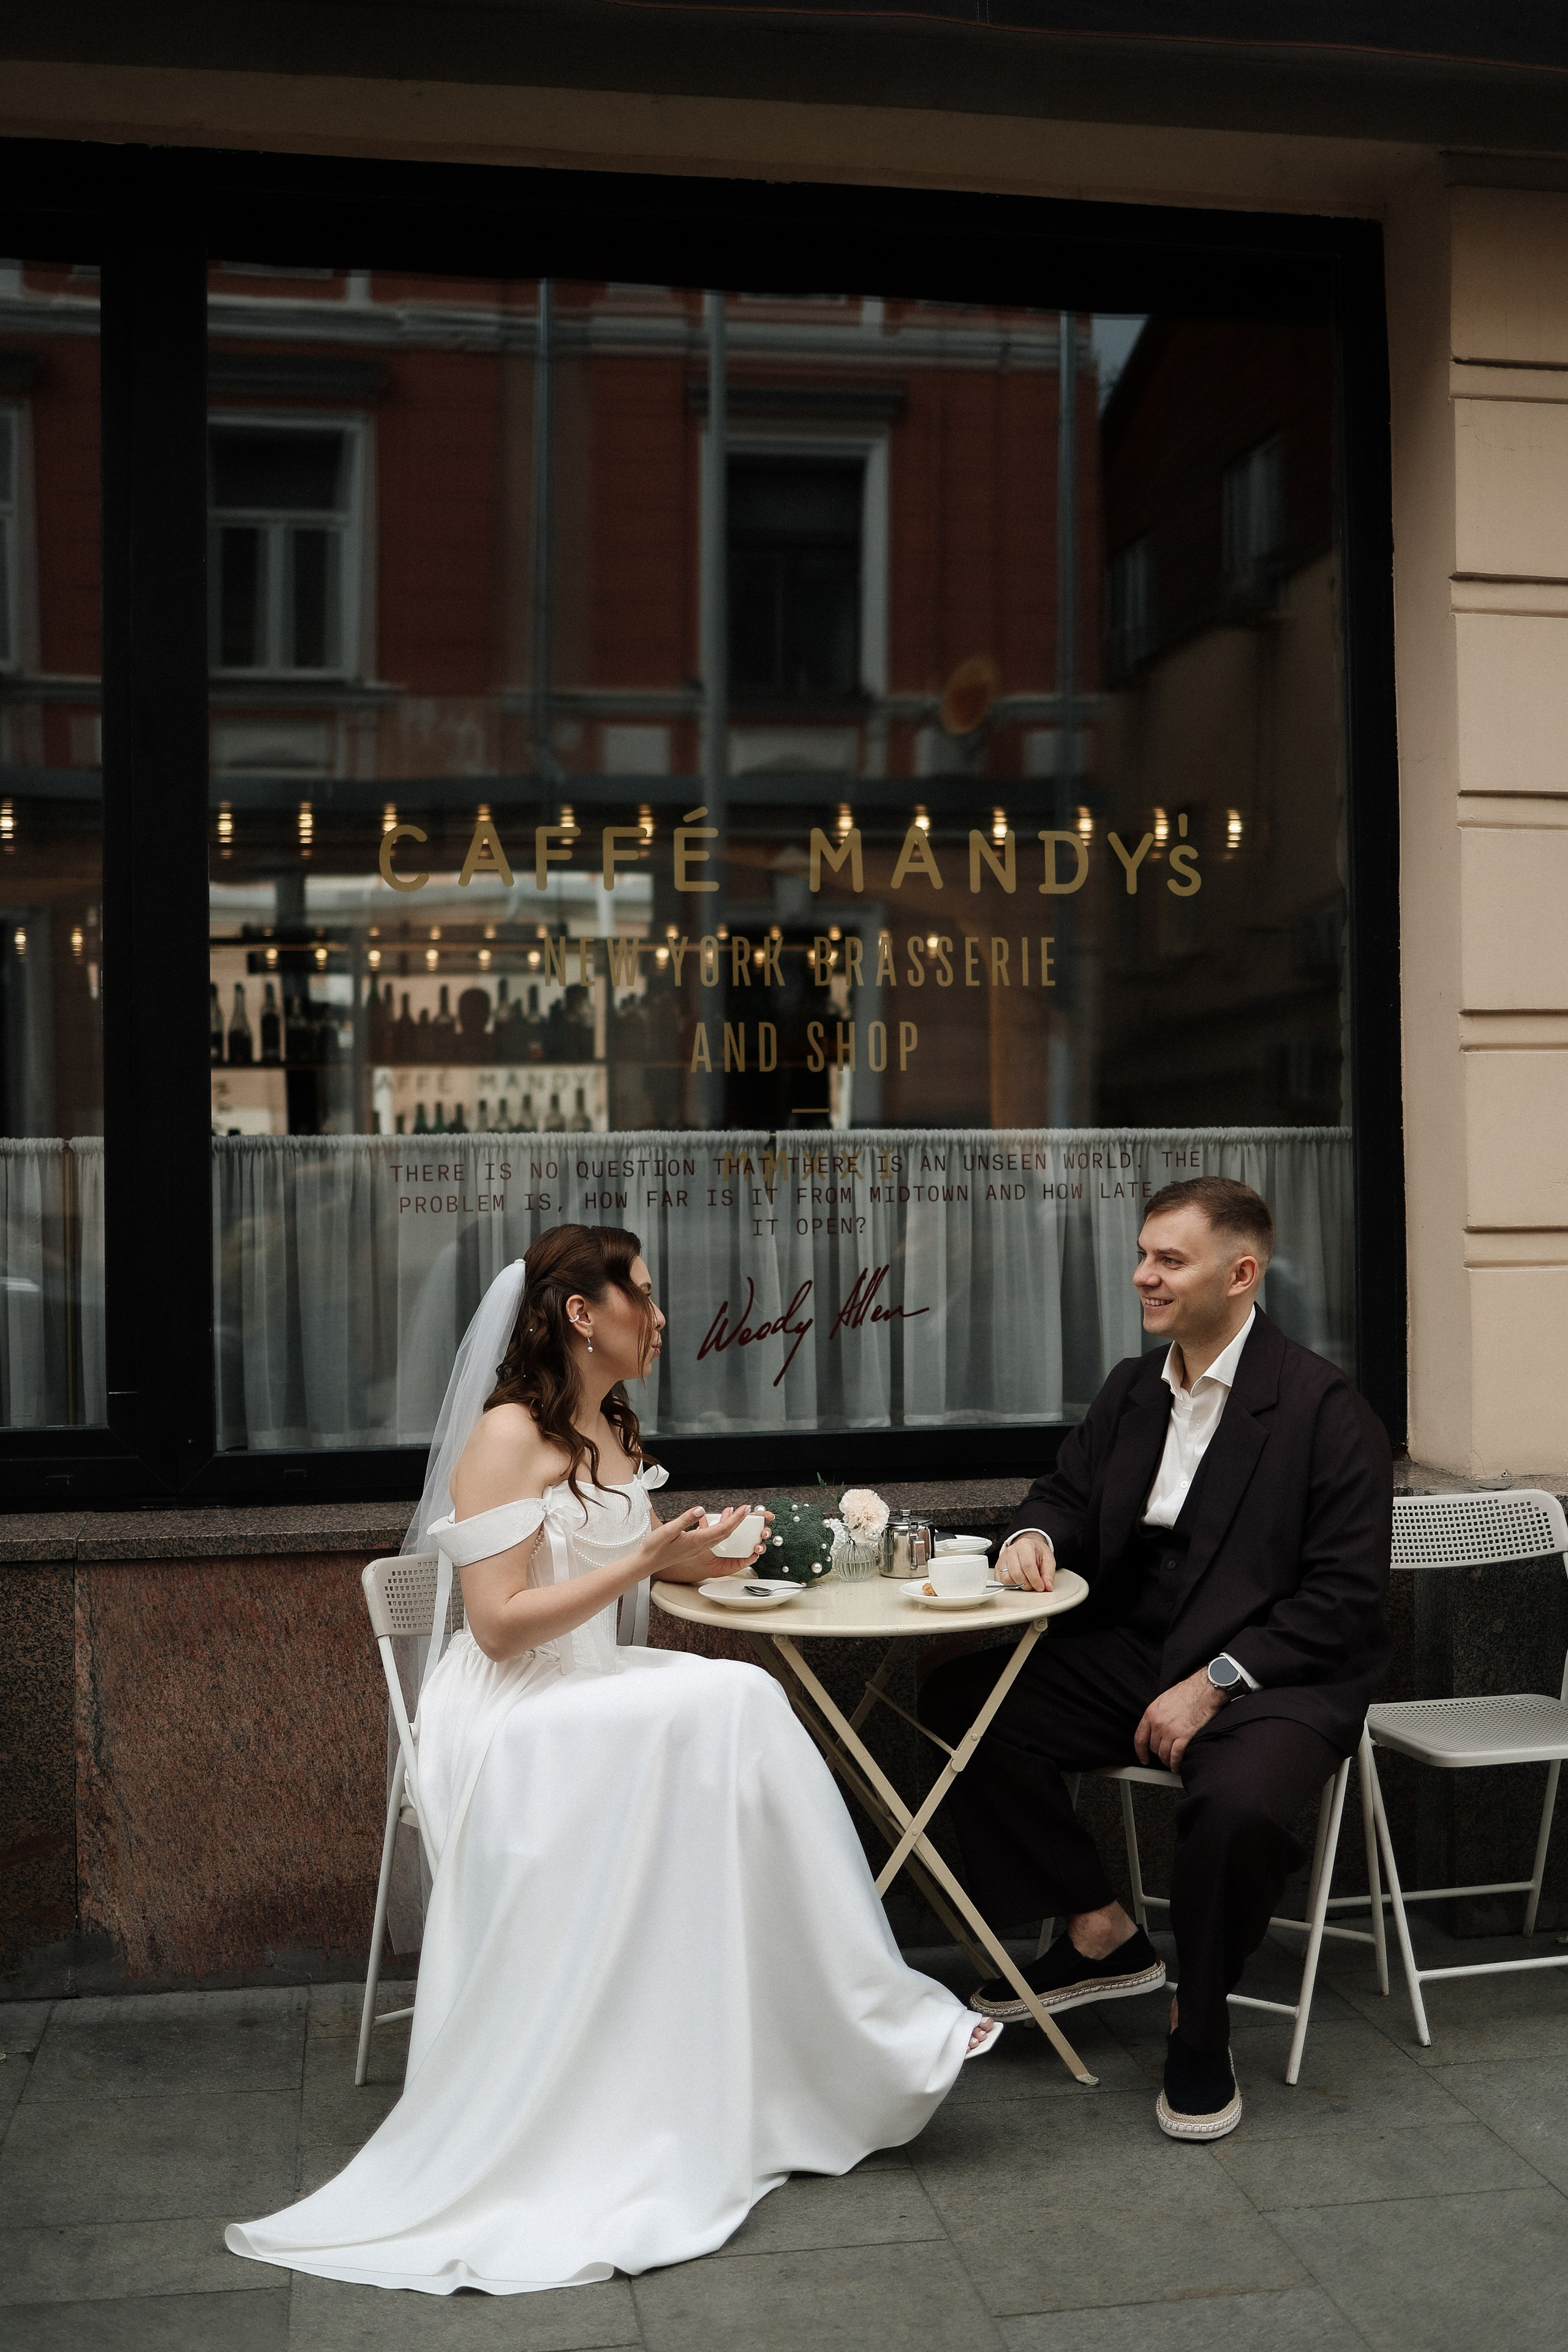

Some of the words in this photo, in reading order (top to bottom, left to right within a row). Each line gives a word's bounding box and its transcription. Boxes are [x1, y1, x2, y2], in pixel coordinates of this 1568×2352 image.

[379, 806, 720, 892] CAFFÉ
[543, 936, 640, 987] NEW
[668, 935, 786, 987] YORK
[813, 937, 1056, 987] BRASSERIE
[690, 1022, 777, 1073] AND
[806, 1021, 918, 1072] SHOP
[390, 1164, 465, 1183] THERE
[485, 1163, 511, 1180] IS
[530, 1162, 558, 1180] NO
[576, 1159, 695, 1180] QUESTION
[713, 1158, 770, 1175] THAT
[787, 1156, 858, 1174] THERE
[877, 1156, 902, 1173] IS
[921, 1155, 946, 1172] AN
[963, 1153, 1046, 1171] UNSEEN
[1063, 1152, 1142, 1170] WORLD.
[1161, 1151, 1200, 1167] THE
[399, 1194, 505, 1214] PROBLEM
[525, 1193, 564, 1213] IS,
[585, 1191, 628, 1210] HOW
[646, 1190, 688, 1208] FAR
[707, 1189, 733, 1207] IS
[752, 1189, 778, 1205] IT
[797, 1187, 851, 1204] FROM
[870, 1185, 968, 1204] MIDTOWN
[986, 1183, 1026, 1201] AND
[1043, 1183, 1082, 1200] HOW
[1100, 1182, 1152, 1199] LATE
[753, 1219, 778, 1236] IT
[796, 1217, 866, 1235] OPEN?
[829, 1264, 930, 1340] Allen
